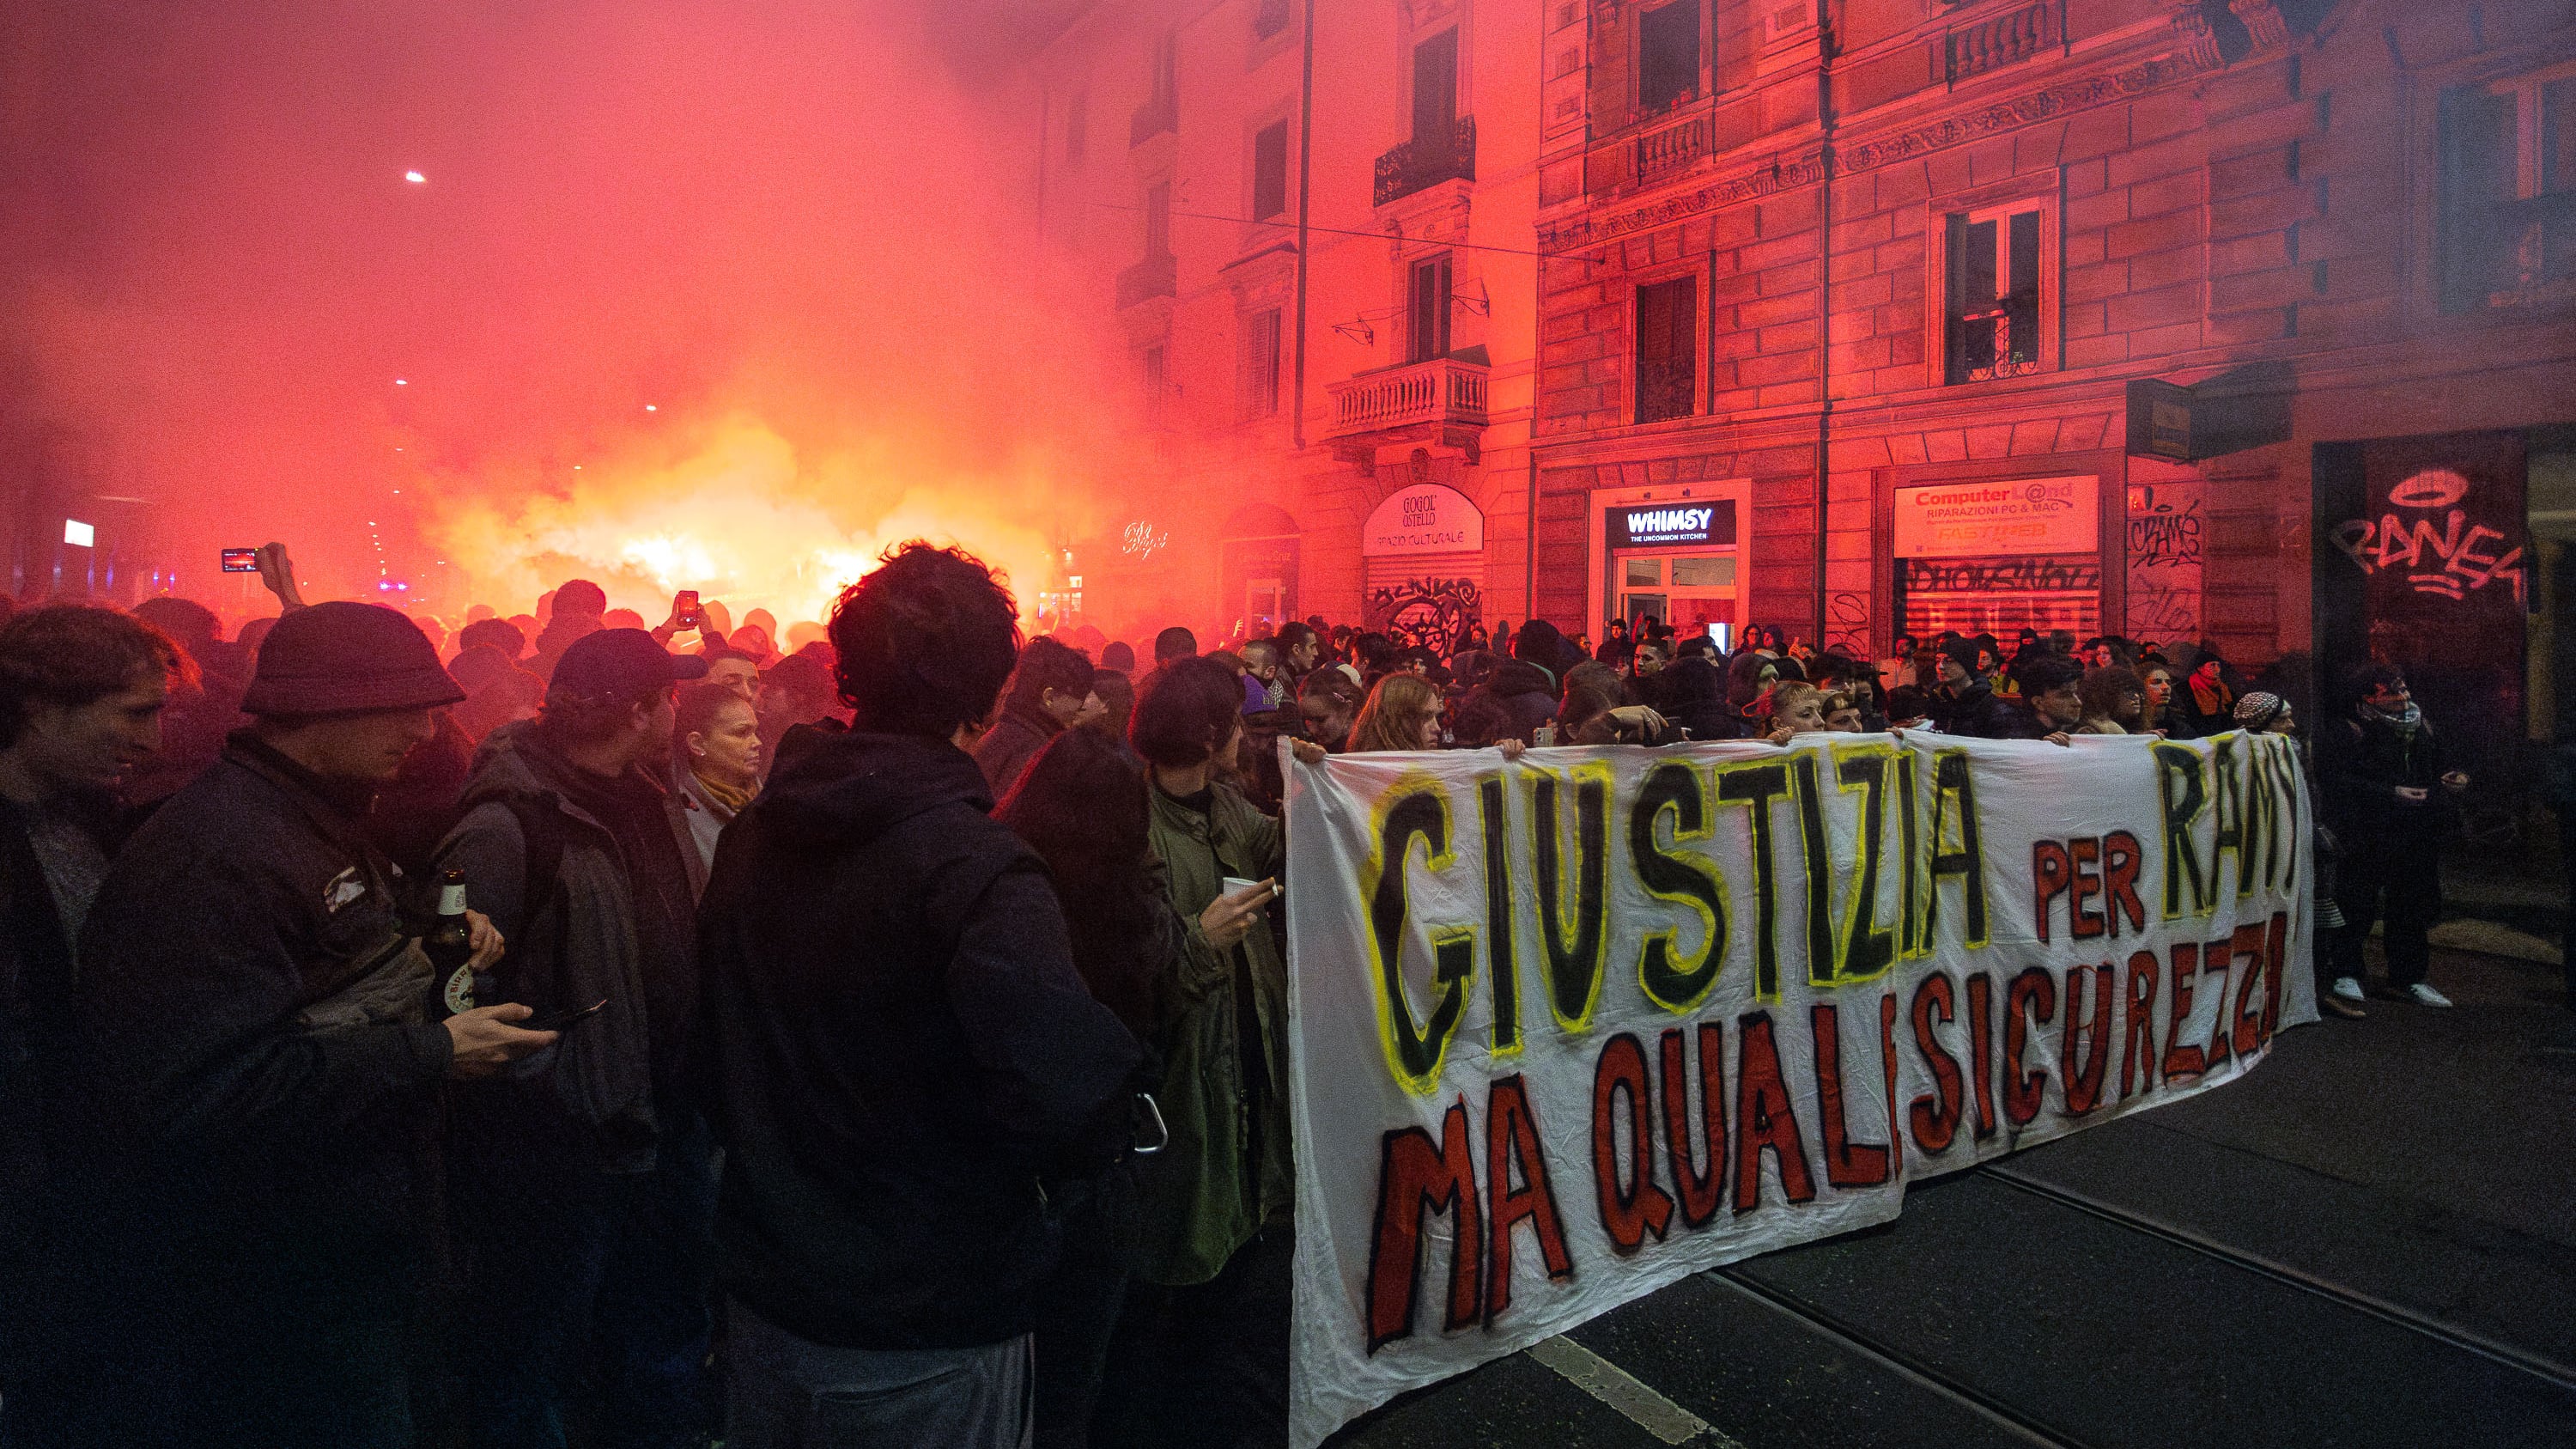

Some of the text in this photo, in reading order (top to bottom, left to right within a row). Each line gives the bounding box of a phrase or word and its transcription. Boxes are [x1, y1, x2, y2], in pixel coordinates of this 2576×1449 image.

[1403, 513, 1436, 527] OSTELLO
[1627, 508, 1713, 533] WHIMSY
[1927, 502, 2059, 519] RIPARAZIONI PC & MAC
[1408, 531, 1464, 546] CULTURALE
[1359, 740, 1989, 1097] GIUSTIZIA
[2032, 830, 2145, 945] PER
[1366, 1071, 1573, 1357] MA
